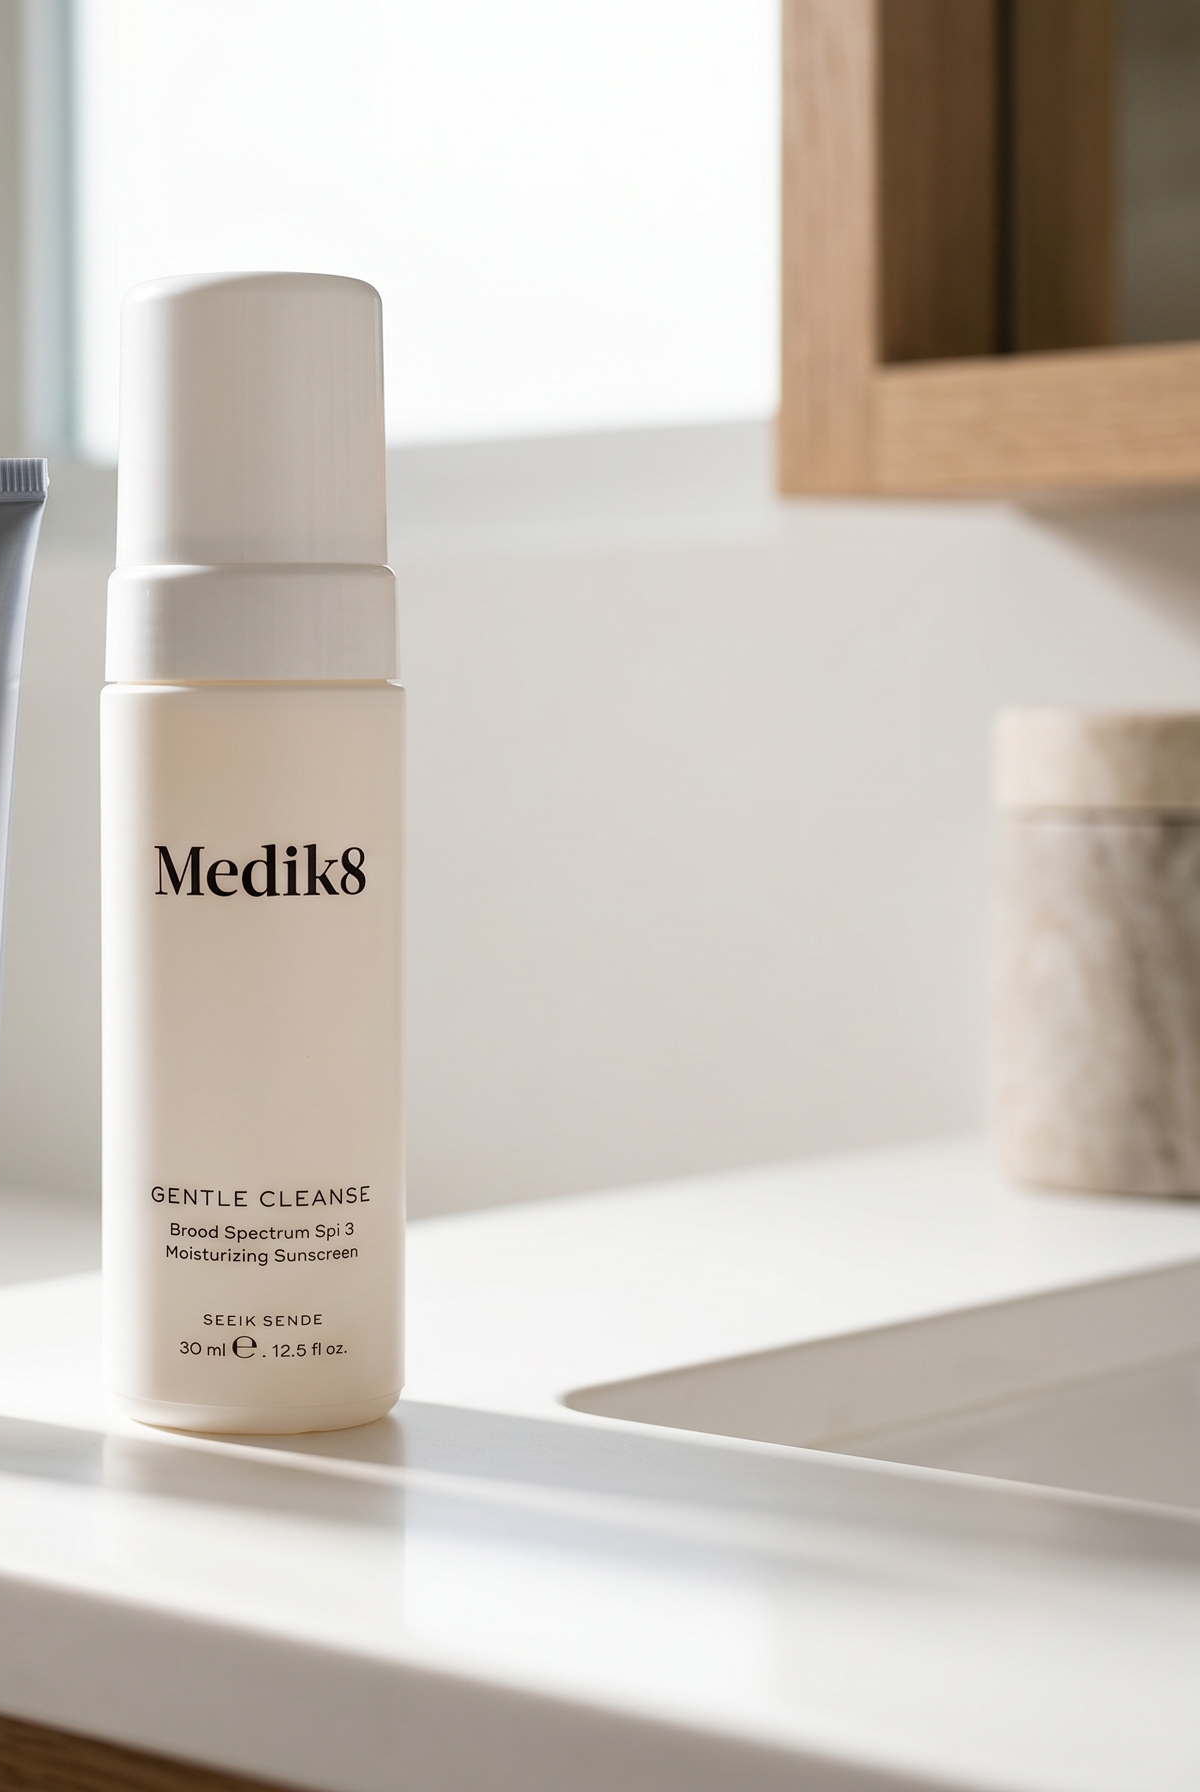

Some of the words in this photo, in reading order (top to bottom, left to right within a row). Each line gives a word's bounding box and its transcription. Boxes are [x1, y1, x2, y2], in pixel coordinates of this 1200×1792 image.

[154, 843, 367, 897] Medik8
[151, 1186, 248, 1207] GENTLE
[259, 1185, 371, 1208] CLEANSE
[170, 1222, 219, 1239] Brood
[224, 1226, 310, 1243] Spectrum
[315, 1223, 341, 1241] Spi
[345, 1222, 355, 1236] 3
[166, 1245, 269, 1267] Moisturizing
[274, 1247, 359, 1263] Sunscreen
[203, 1314, 257, 1327] SEEIK
[263, 1314, 323, 1327] SENDE
[179, 1341, 202, 1356] 30
[207, 1343, 226, 1357] ml
[272, 1344, 307, 1358] 12.5
[312, 1342, 322, 1356] fl
[326, 1343, 348, 1355] oz.
